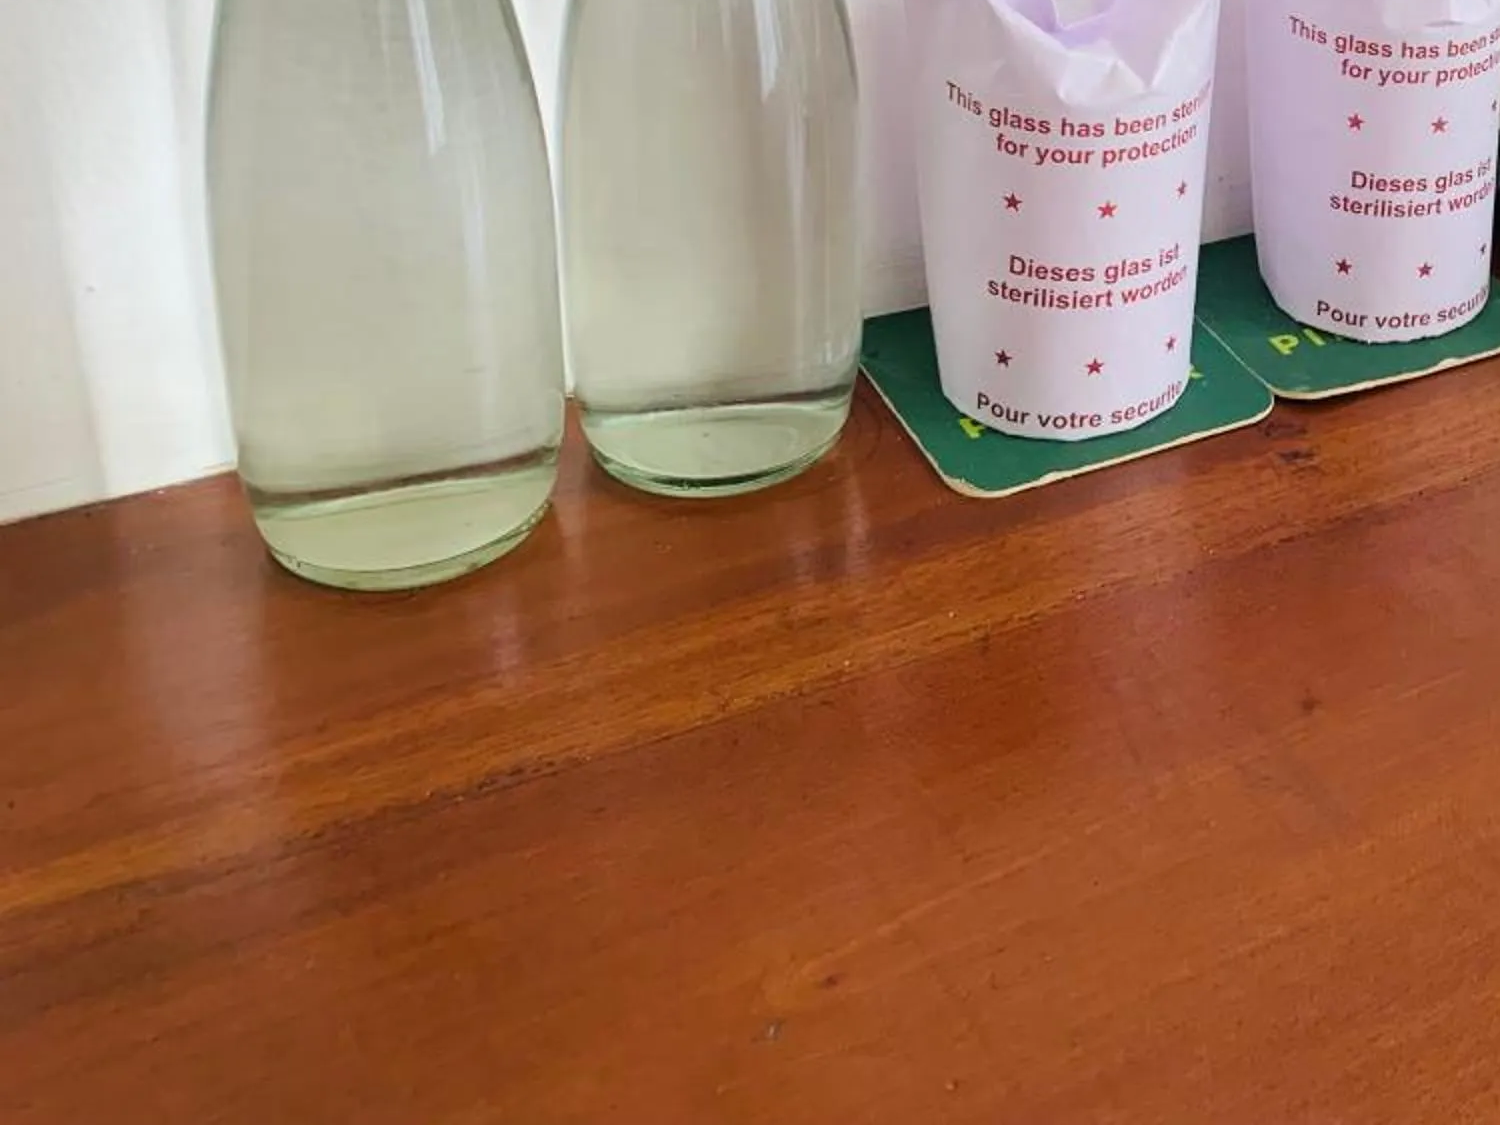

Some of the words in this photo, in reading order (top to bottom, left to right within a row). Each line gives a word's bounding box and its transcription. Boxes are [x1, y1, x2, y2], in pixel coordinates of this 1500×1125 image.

[1289, 14, 1328, 44] This
[1334, 35, 1393, 58] glass
[1401, 42, 1440, 60] has
[1447, 37, 1487, 58] been
[1340, 58, 1373, 80] for
[1377, 68, 1431, 87] your
[945, 80, 983, 117] This
[989, 106, 1051, 135] glass
[1060, 117, 1105, 138] has
[1113, 113, 1167, 137] been
[996, 132, 1029, 158] for
[1035, 147, 1094, 166] your
[1101, 124, 1198, 168] protection
[1351, 170, 1428, 192] Dieses
[1434, 170, 1473, 194] glas
[1329, 193, 1442, 219] sterilisiert
[1008, 254, 1095, 282] Dieses
[1103, 258, 1152, 285] glas
[1159, 242, 1179, 268] ist
[987, 279, 1113, 310] sterilisiert
[1316, 299, 1368, 328] Pour
[1374, 311, 1431, 329] votre
[976, 391, 1031, 425] Pour
[1037, 410, 1102, 430] votre
